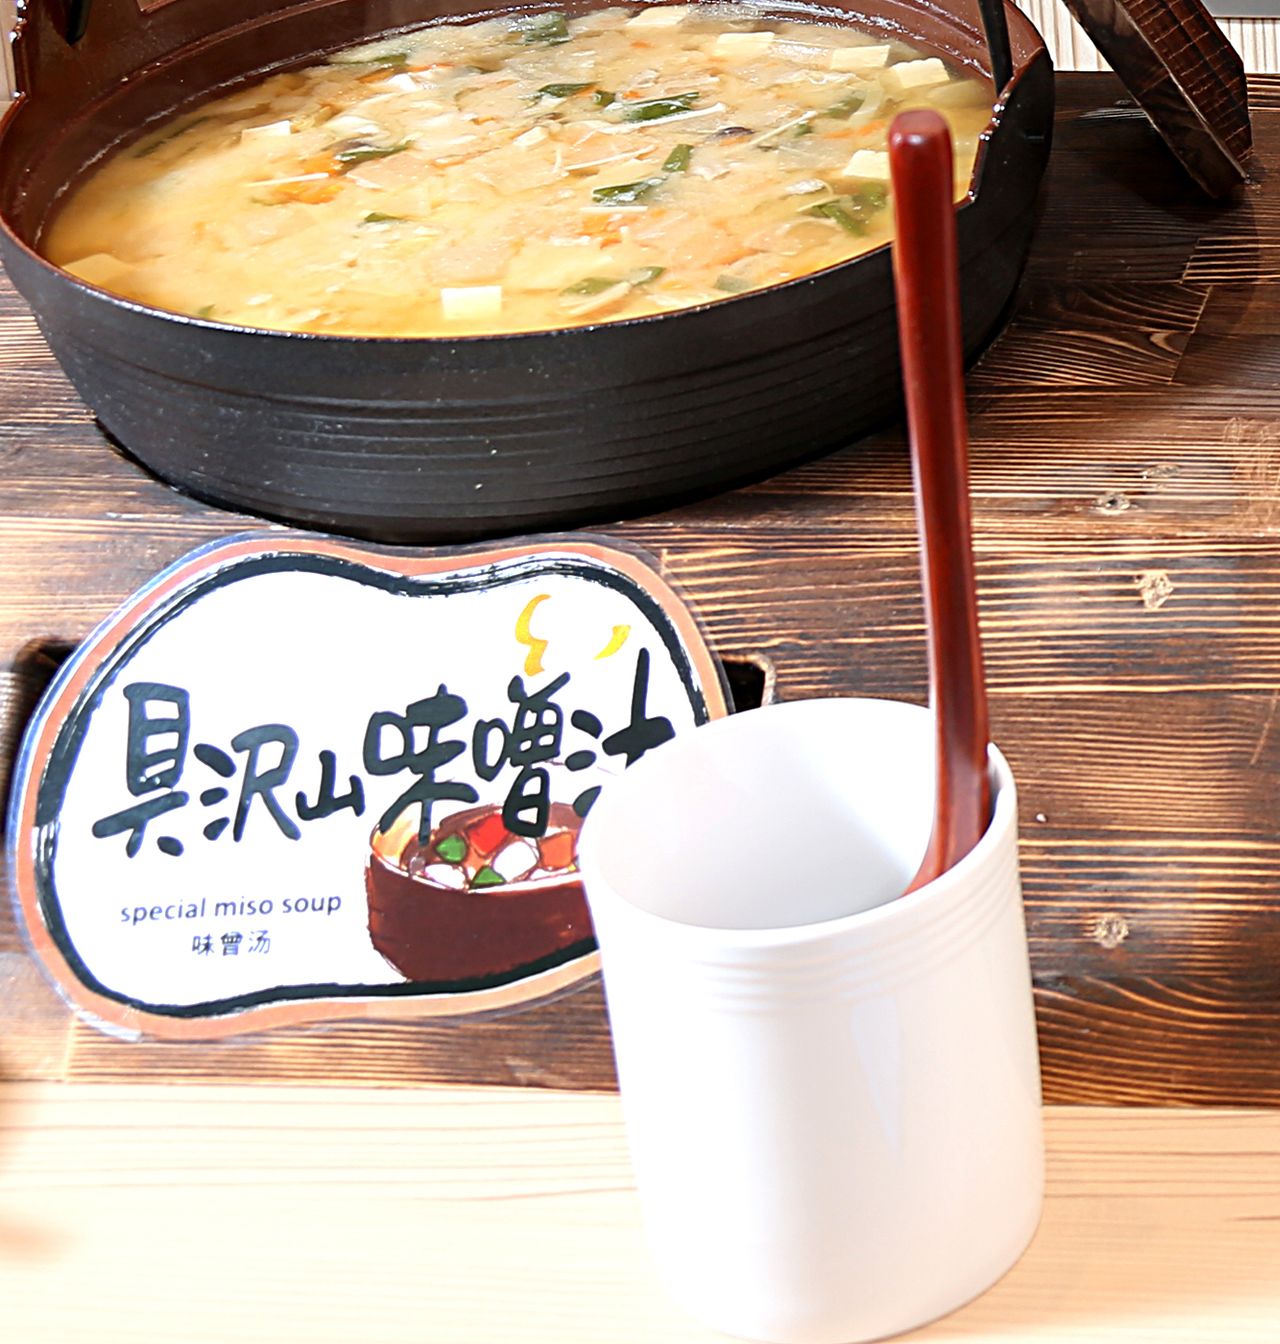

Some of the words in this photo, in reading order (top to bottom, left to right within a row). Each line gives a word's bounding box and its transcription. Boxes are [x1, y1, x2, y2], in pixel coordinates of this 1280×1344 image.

[92, 647, 675, 858] 具沢山味噌汁
[120, 898, 205, 926] special
[214, 896, 273, 917] miso
[282, 895, 342, 916] soup
[191, 929, 271, 956] 味曾汤
